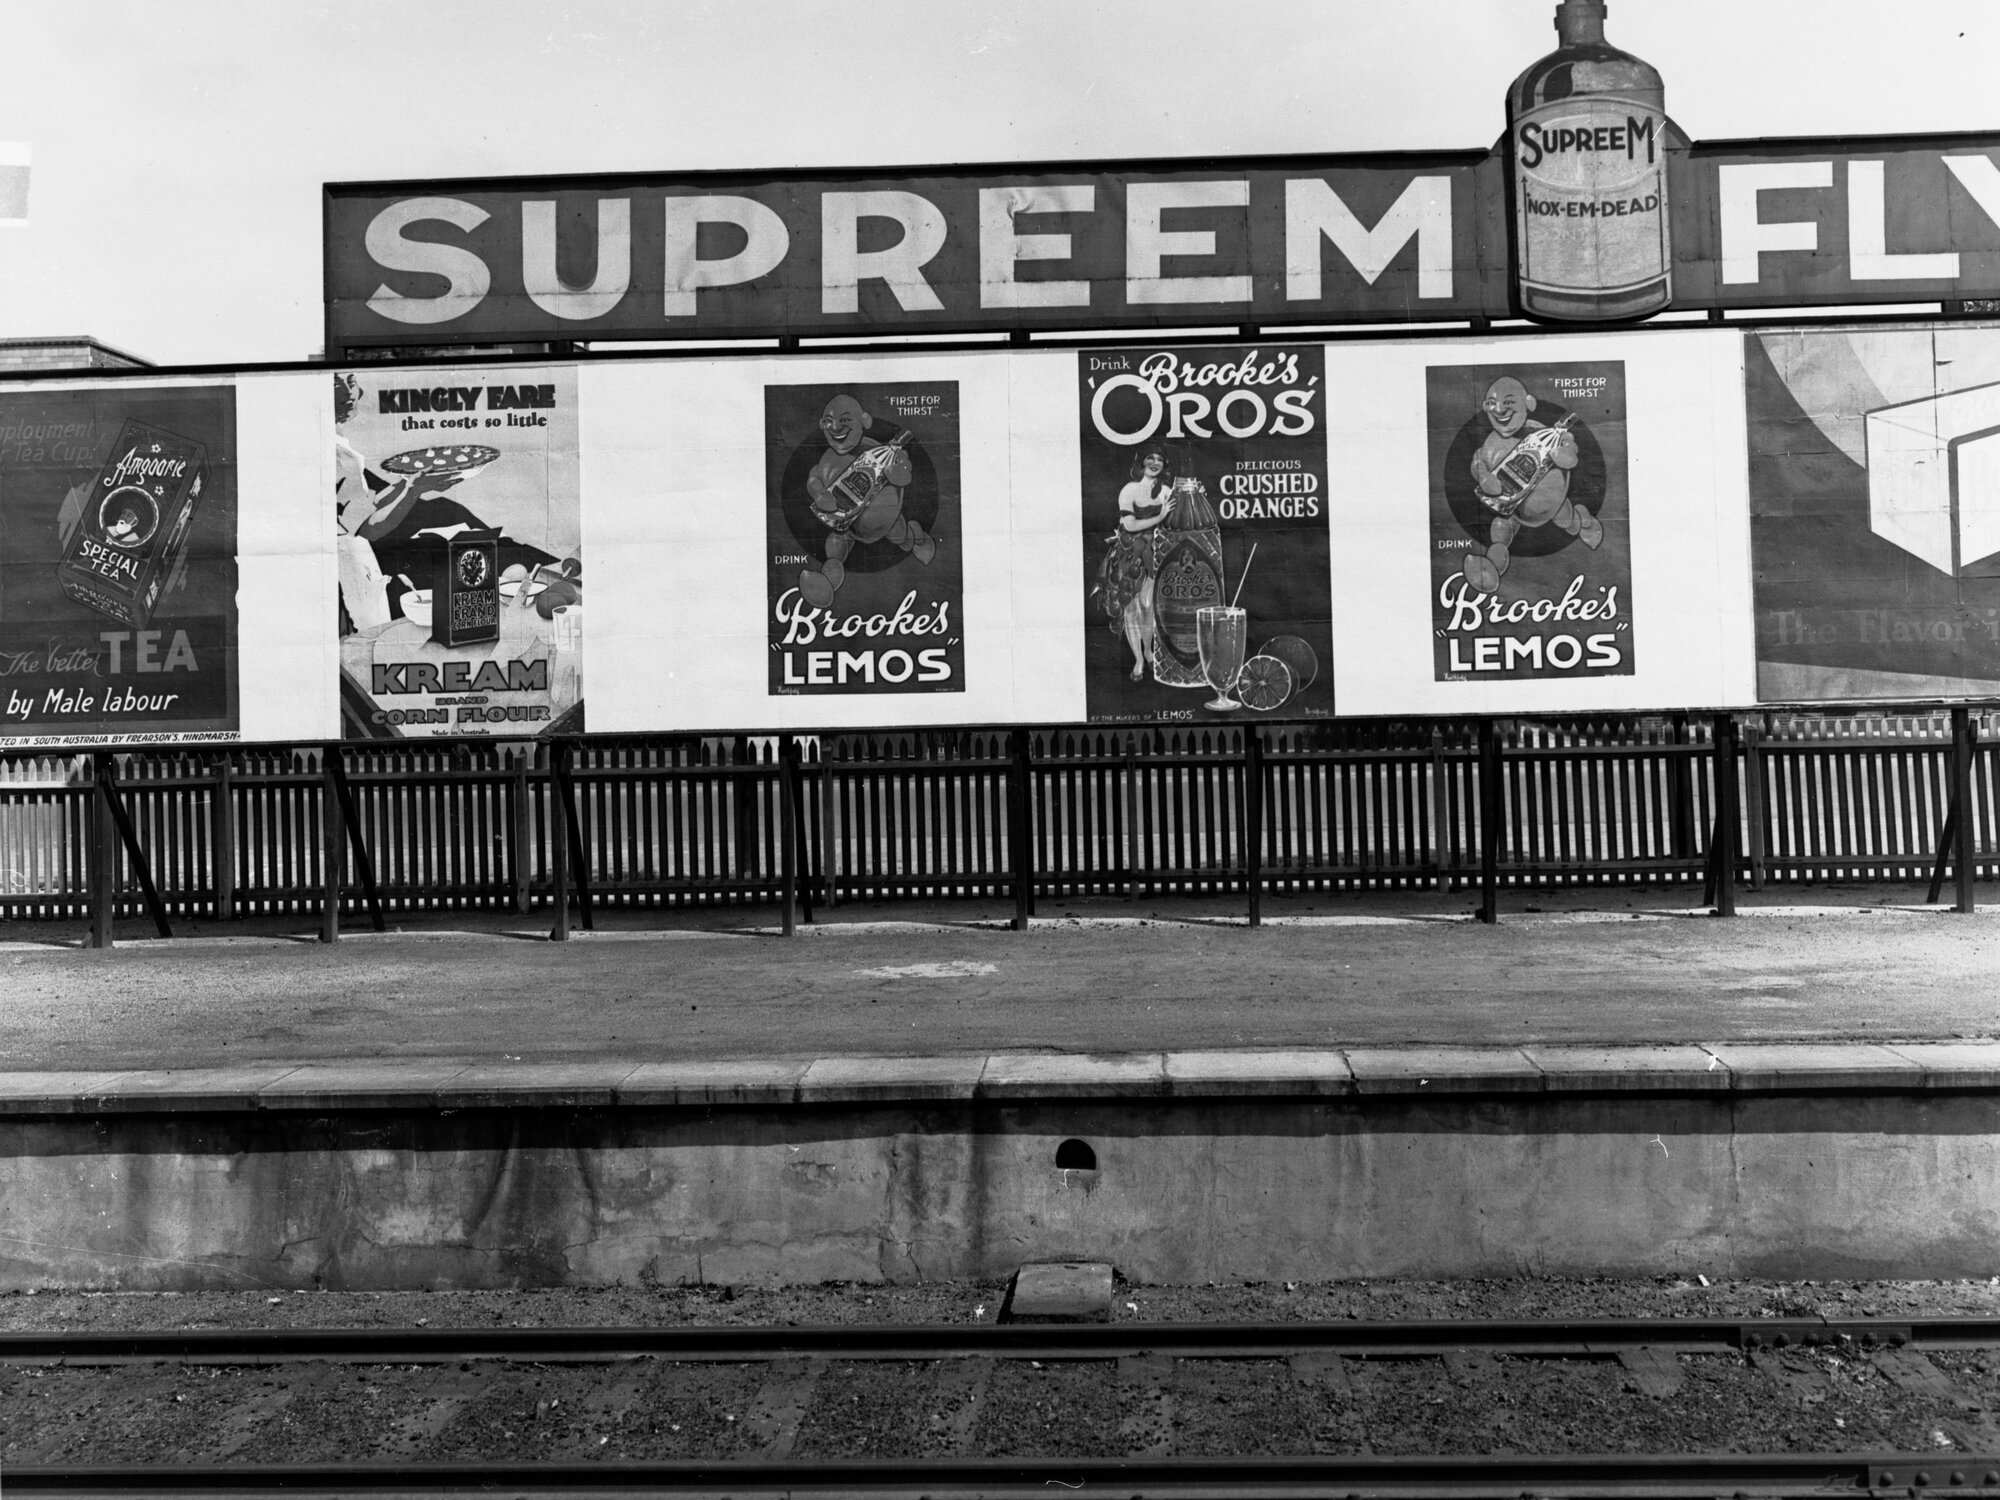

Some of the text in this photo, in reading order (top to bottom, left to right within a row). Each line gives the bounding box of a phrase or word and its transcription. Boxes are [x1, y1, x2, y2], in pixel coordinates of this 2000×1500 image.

[1520, 116, 1655, 168] SUPREEM
[1527, 195, 1658, 218] NOX-EM-DEAD
[365, 175, 1453, 324] SUPREEM
[1089, 350, 1300, 394] Drink Brooke's
[1586, 377, 1607, 387] FOR
[378, 384, 556, 414] KINGLY FARE
[921, 395, 941, 406] FOR
[1562, 387, 1605, 398] THIRST"
[401, 412, 548, 431] that costs so little
[897, 405, 939, 416] THIRST"
[14, 441, 45, 463] Tea
[1235, 459, 1302, 471] DELICIOUS
[1219, 473, 1318, 495] CRUSHED
[1219, 497, 1319, 520] ORANGES
[1438, 539, 1473, 550] DRINK
[79, 540, 139, 580] SPECIAL
[91, 558, 119, 581] TEA
[775, 555, 808, 565] DRINK
[453, 589, 496, 609] KREAM
[1161, 584, 1217, 598] OROS
[1439, 572, 1618, 632] Brooke's
[453, 604, 496, 621] BRAND
[472, 616, 498, 628] FLOUR
[775, 587, 949, 645] Brooke's
[1769, 608, 1838, 646] The
[1855, 607, 1971, 644] Flavor
[0, 629, 200, 678] The better TEA
[371, 660, 548, 695] KREAM
[6, 686, 179, 720] by Male labour
[435, 695, 489, 706] BRAND
[371, 705, 551, 725] CORN FLOUR
[19, 737, 30, 745] IN
[33, 736, 61, 745] SOUTH
[63, 735, 109, 744] AUSTRALIA
[111, 735, 124, 743] BY
